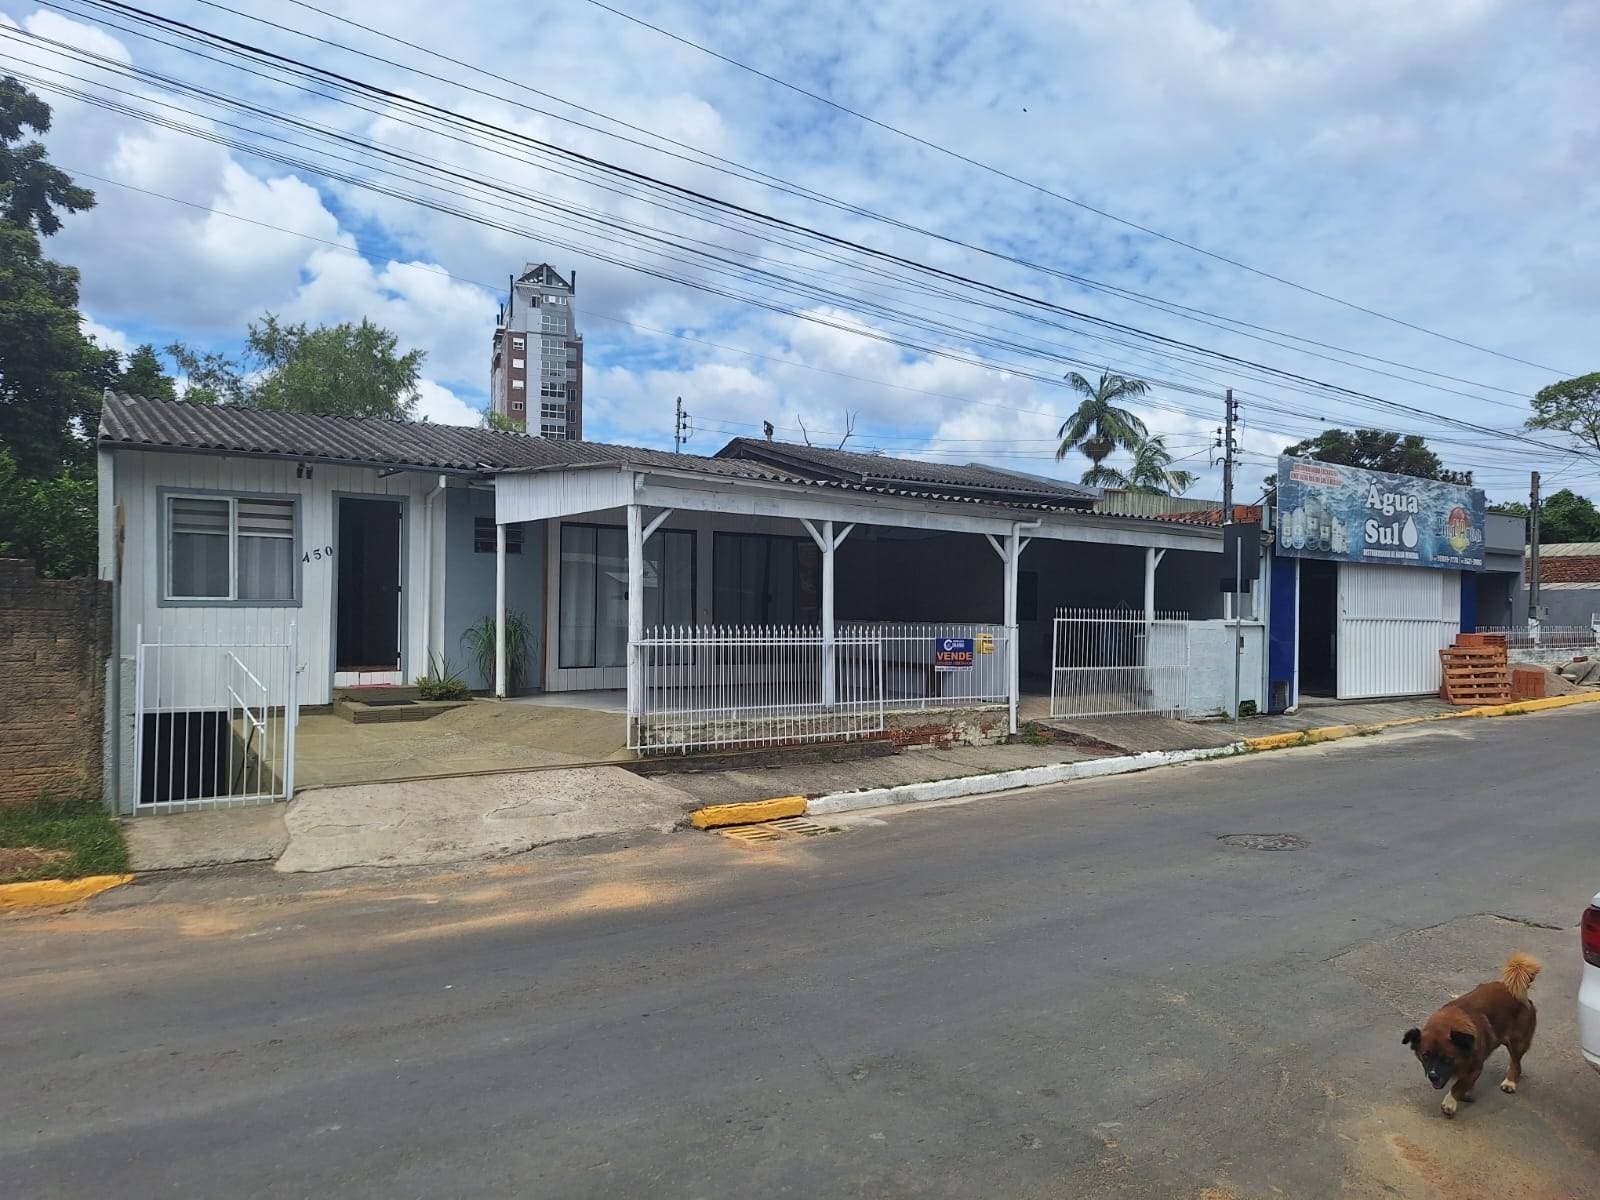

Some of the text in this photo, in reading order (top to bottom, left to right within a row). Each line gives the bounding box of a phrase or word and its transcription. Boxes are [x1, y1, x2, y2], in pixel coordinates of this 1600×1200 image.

[1364, 478, 1419, 516] Água
[1364, 519, 1400, 545] Sul
[936, 651, 973, 661] VENDE
